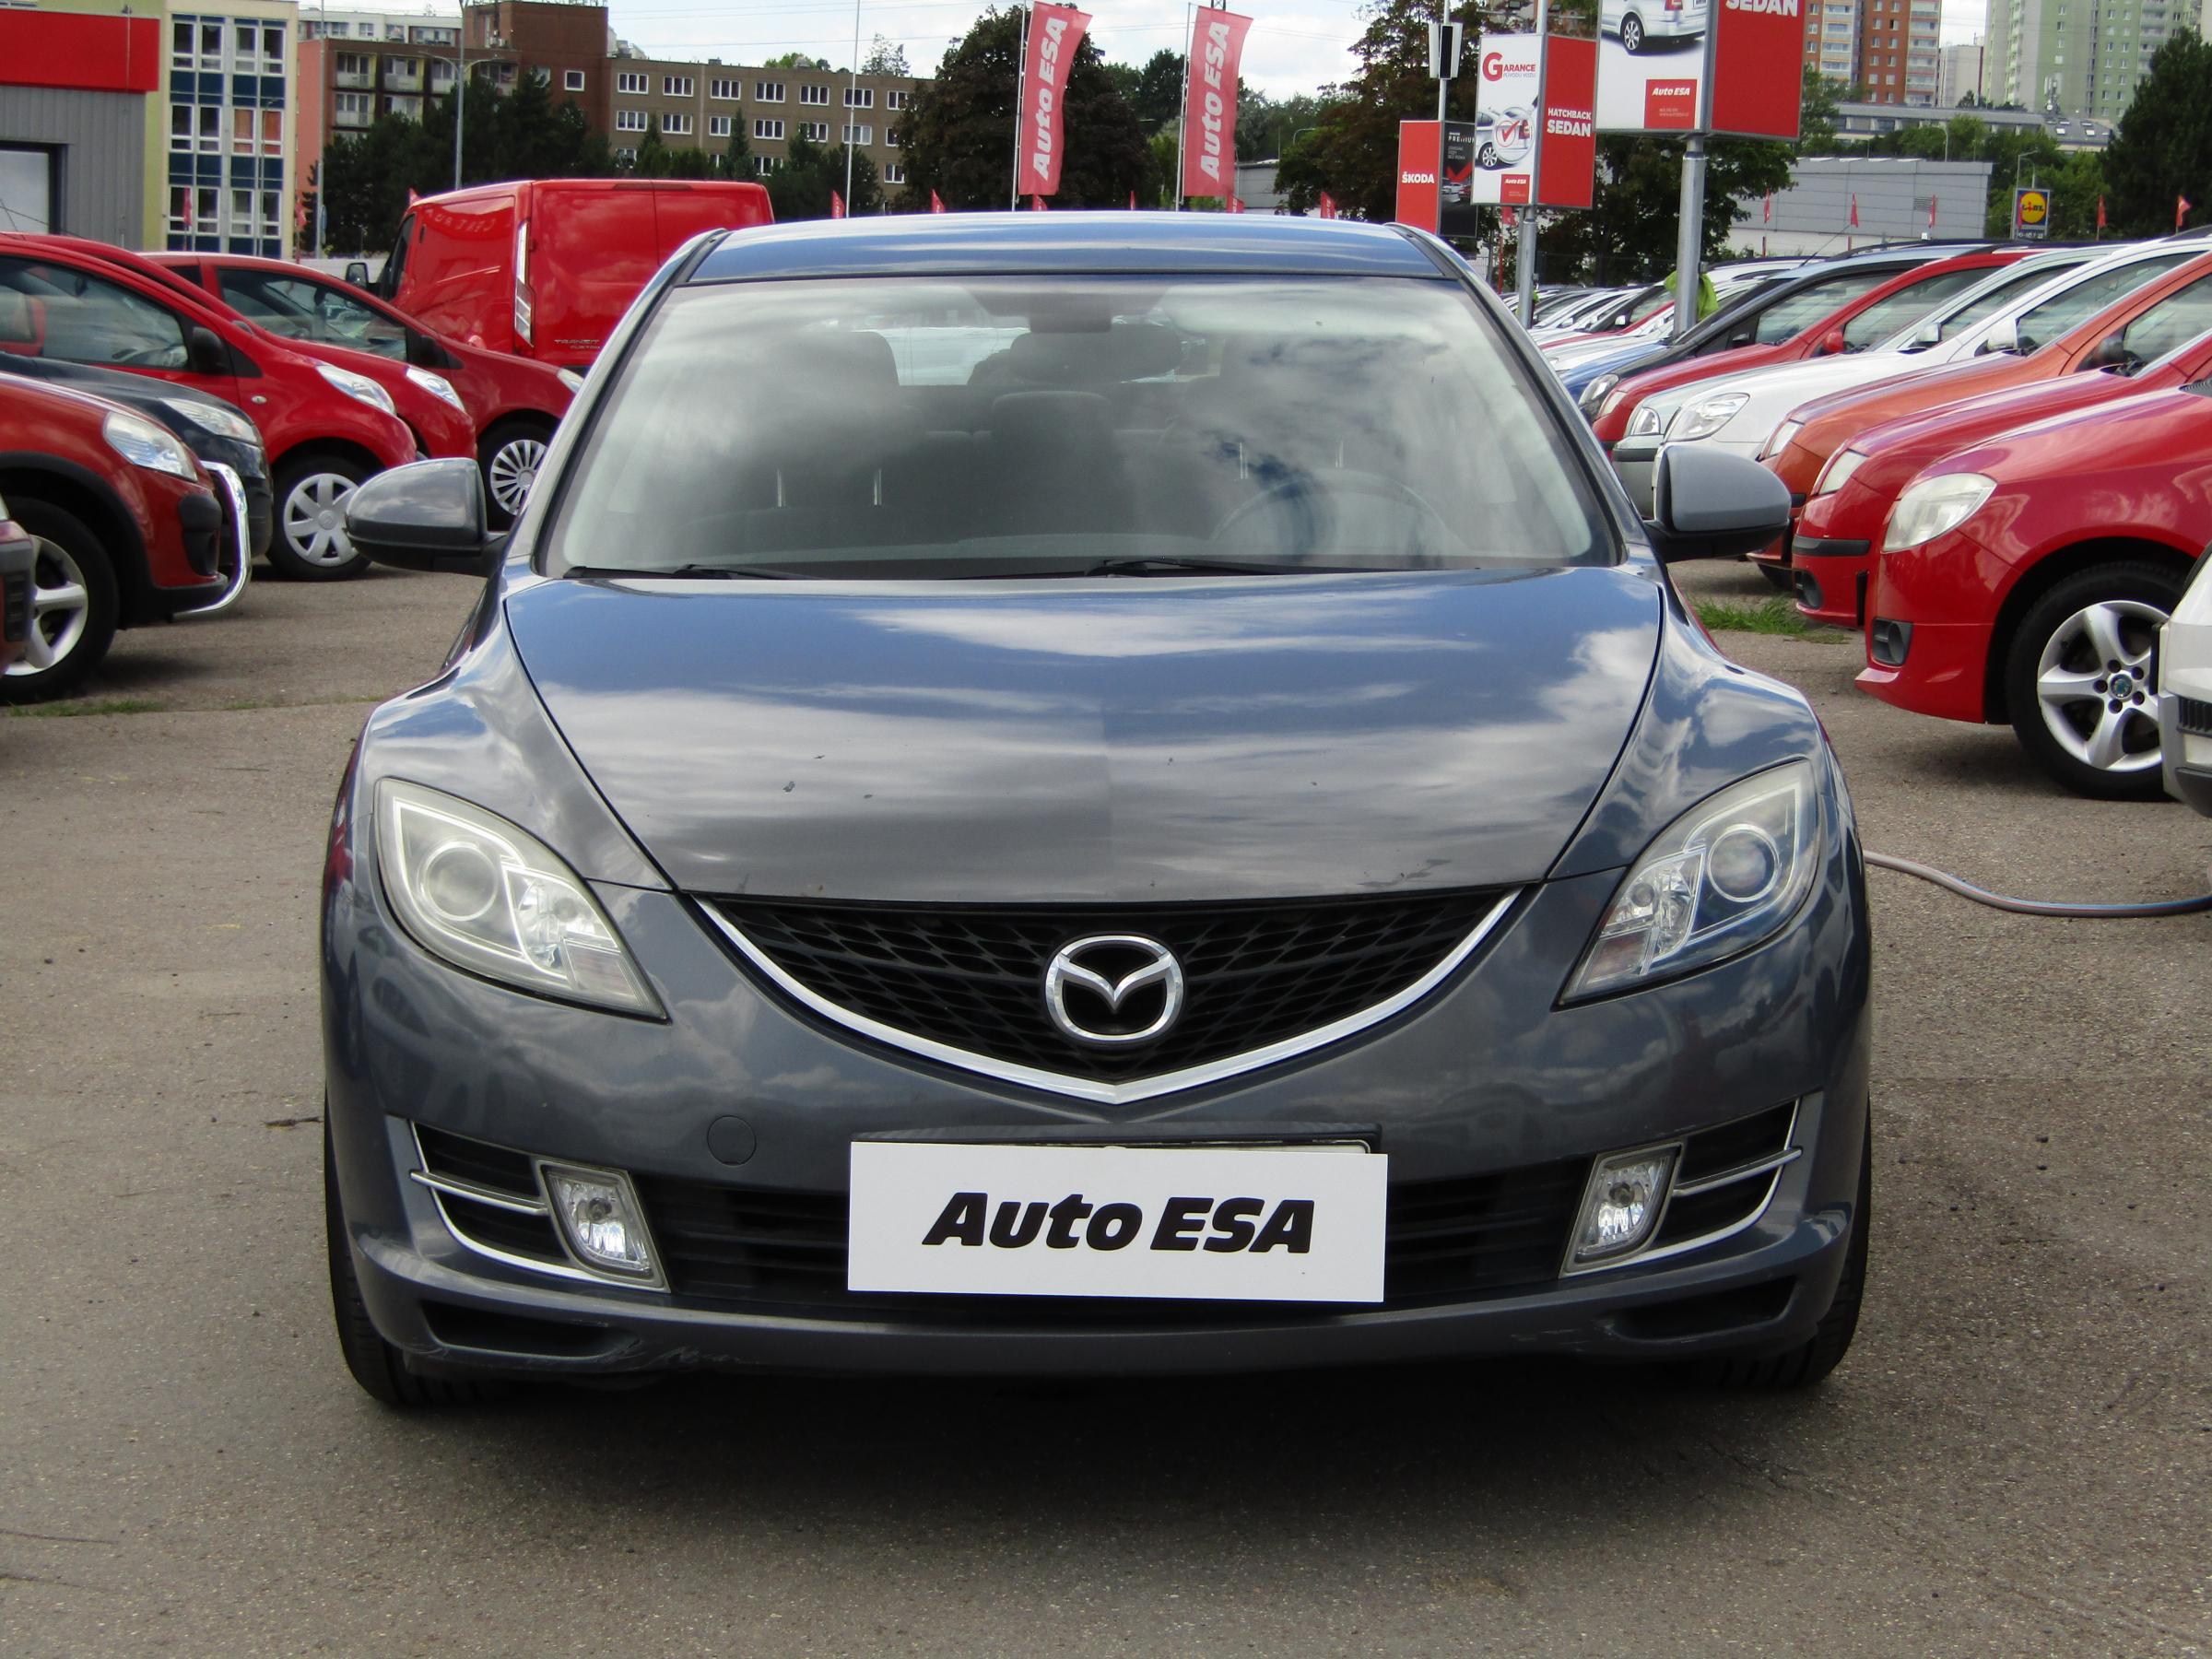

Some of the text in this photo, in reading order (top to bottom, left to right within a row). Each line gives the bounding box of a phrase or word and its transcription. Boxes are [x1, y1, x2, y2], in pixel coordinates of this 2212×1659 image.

[1482, 52, 1536, 82] GARANCE
[1032, 17, 1068, 182] Auto ESA
[1200, 21, 1230, 182] Auto ESA
[1652, 87, 1690, 96] Auto ESA
[1547, 107, 1592, 121] HATCHBACK
[1547, 119, 1592, 137] SEDAN
[1401, 171, 1435, 183] ŠKODA
[922, 1191, 1315, 1254] Auto ESA
